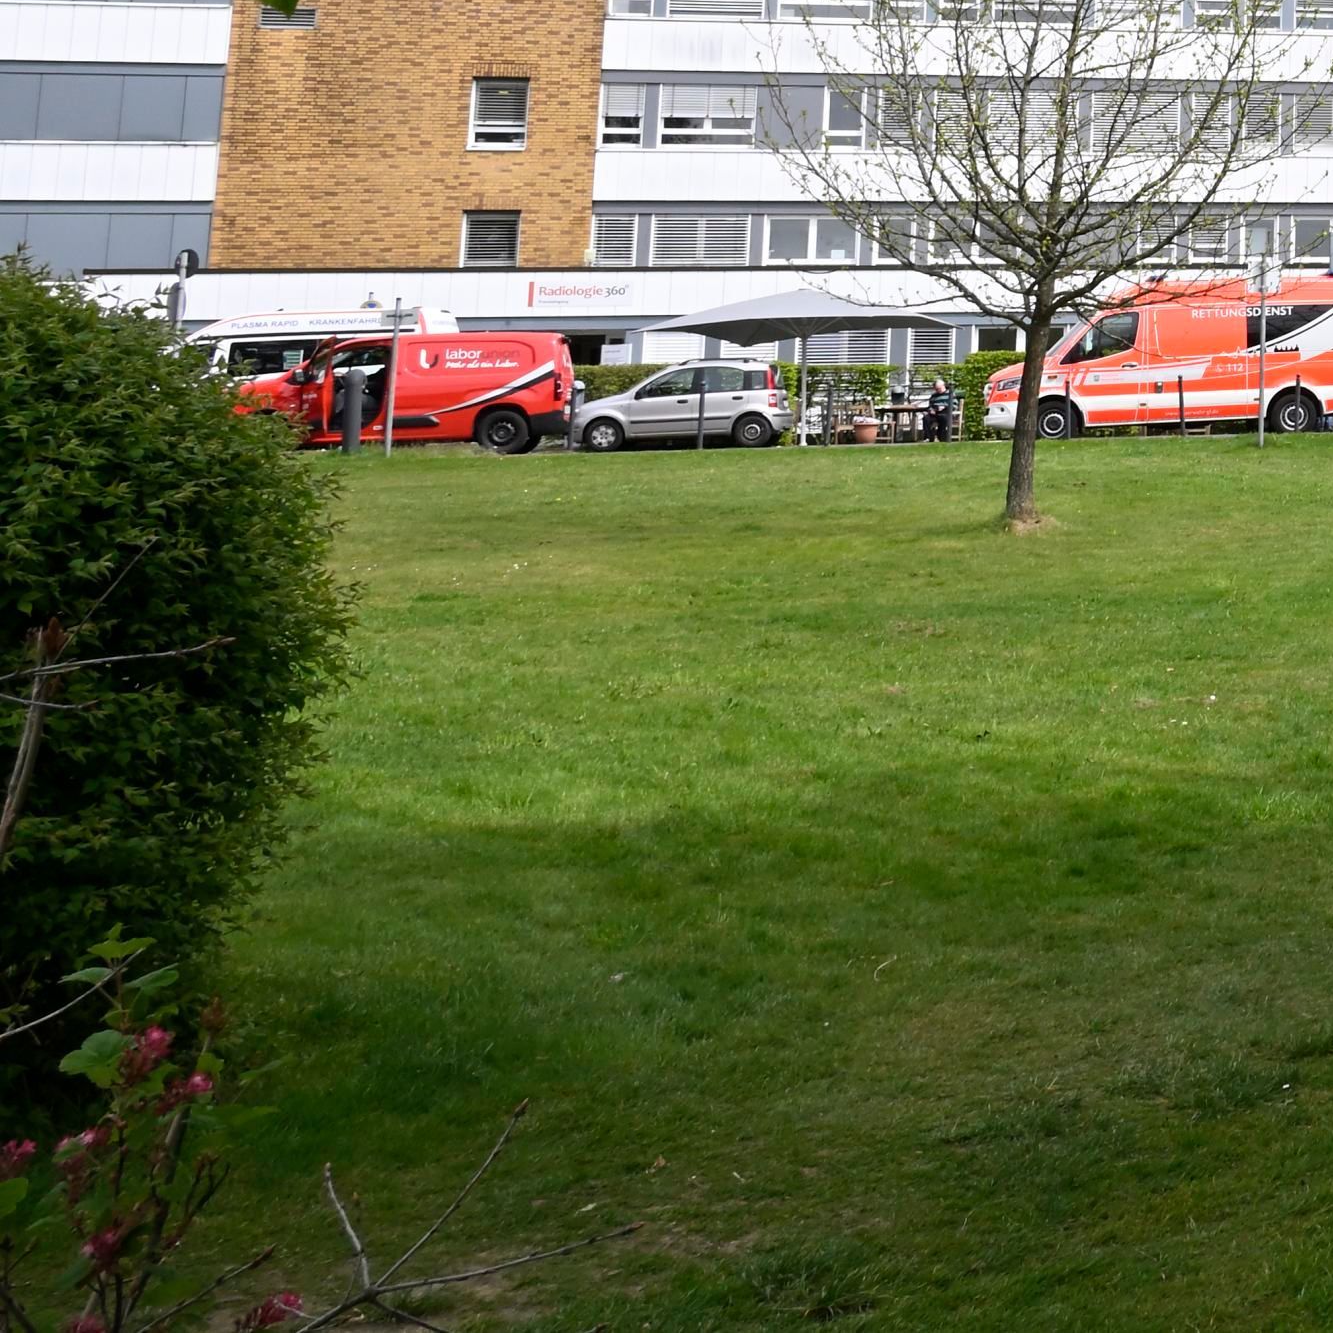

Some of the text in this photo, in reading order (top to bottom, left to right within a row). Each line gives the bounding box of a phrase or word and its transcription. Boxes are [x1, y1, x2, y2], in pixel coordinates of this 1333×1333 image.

[539, 286, 603, 298] Radiologie
[1191, 305, 1294, 319] RETTUNGSDENST
[231, 320, 299, 329] PLASMA RAPID
[1226, 363, 1244, 372] 112
